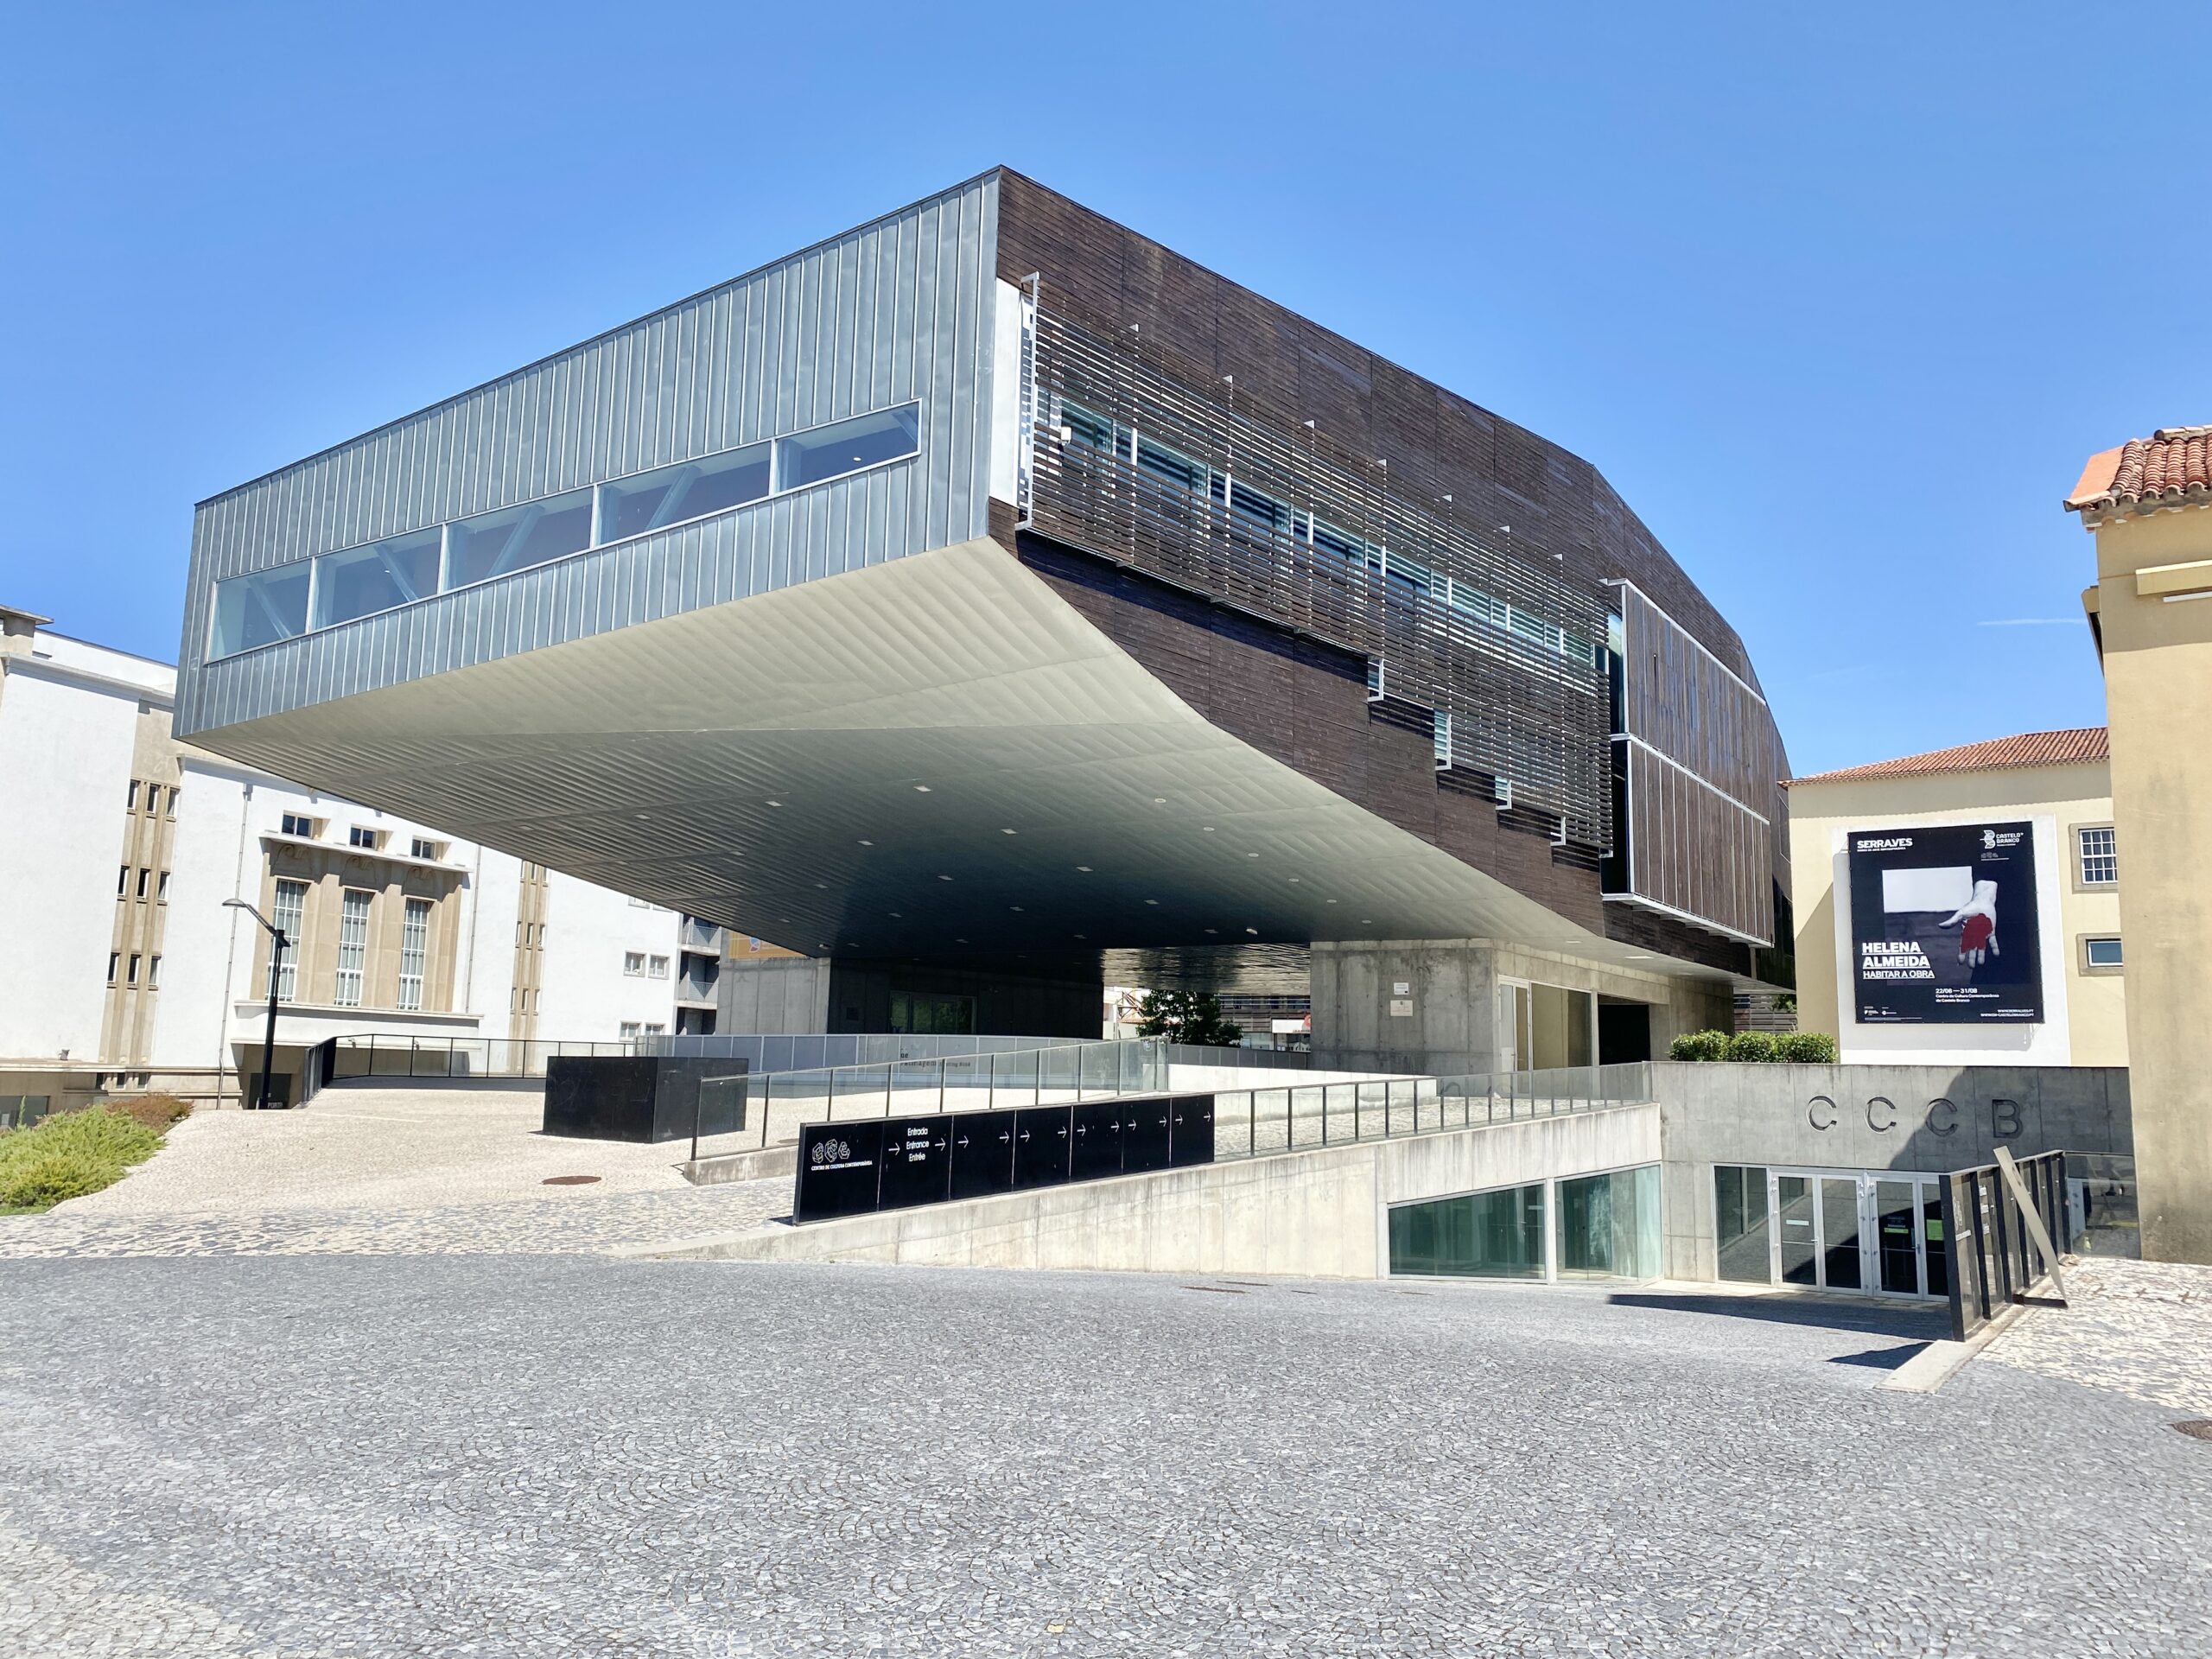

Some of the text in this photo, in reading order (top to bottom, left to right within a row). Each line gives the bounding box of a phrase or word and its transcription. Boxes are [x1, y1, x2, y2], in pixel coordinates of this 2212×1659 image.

[1862, 941, 1922, 953] HELENA
[1863, 955, 1930, 967] ALMEIDA
[1863, 970, 1900, 979] HABITAR
[1909, 969, 1935, 978] OBRA
[907, 1128, 928, 1136] Entrada
[906, 1141, 930, 1150] Entrance
[909, 1152, 925, 1162] Entrée
